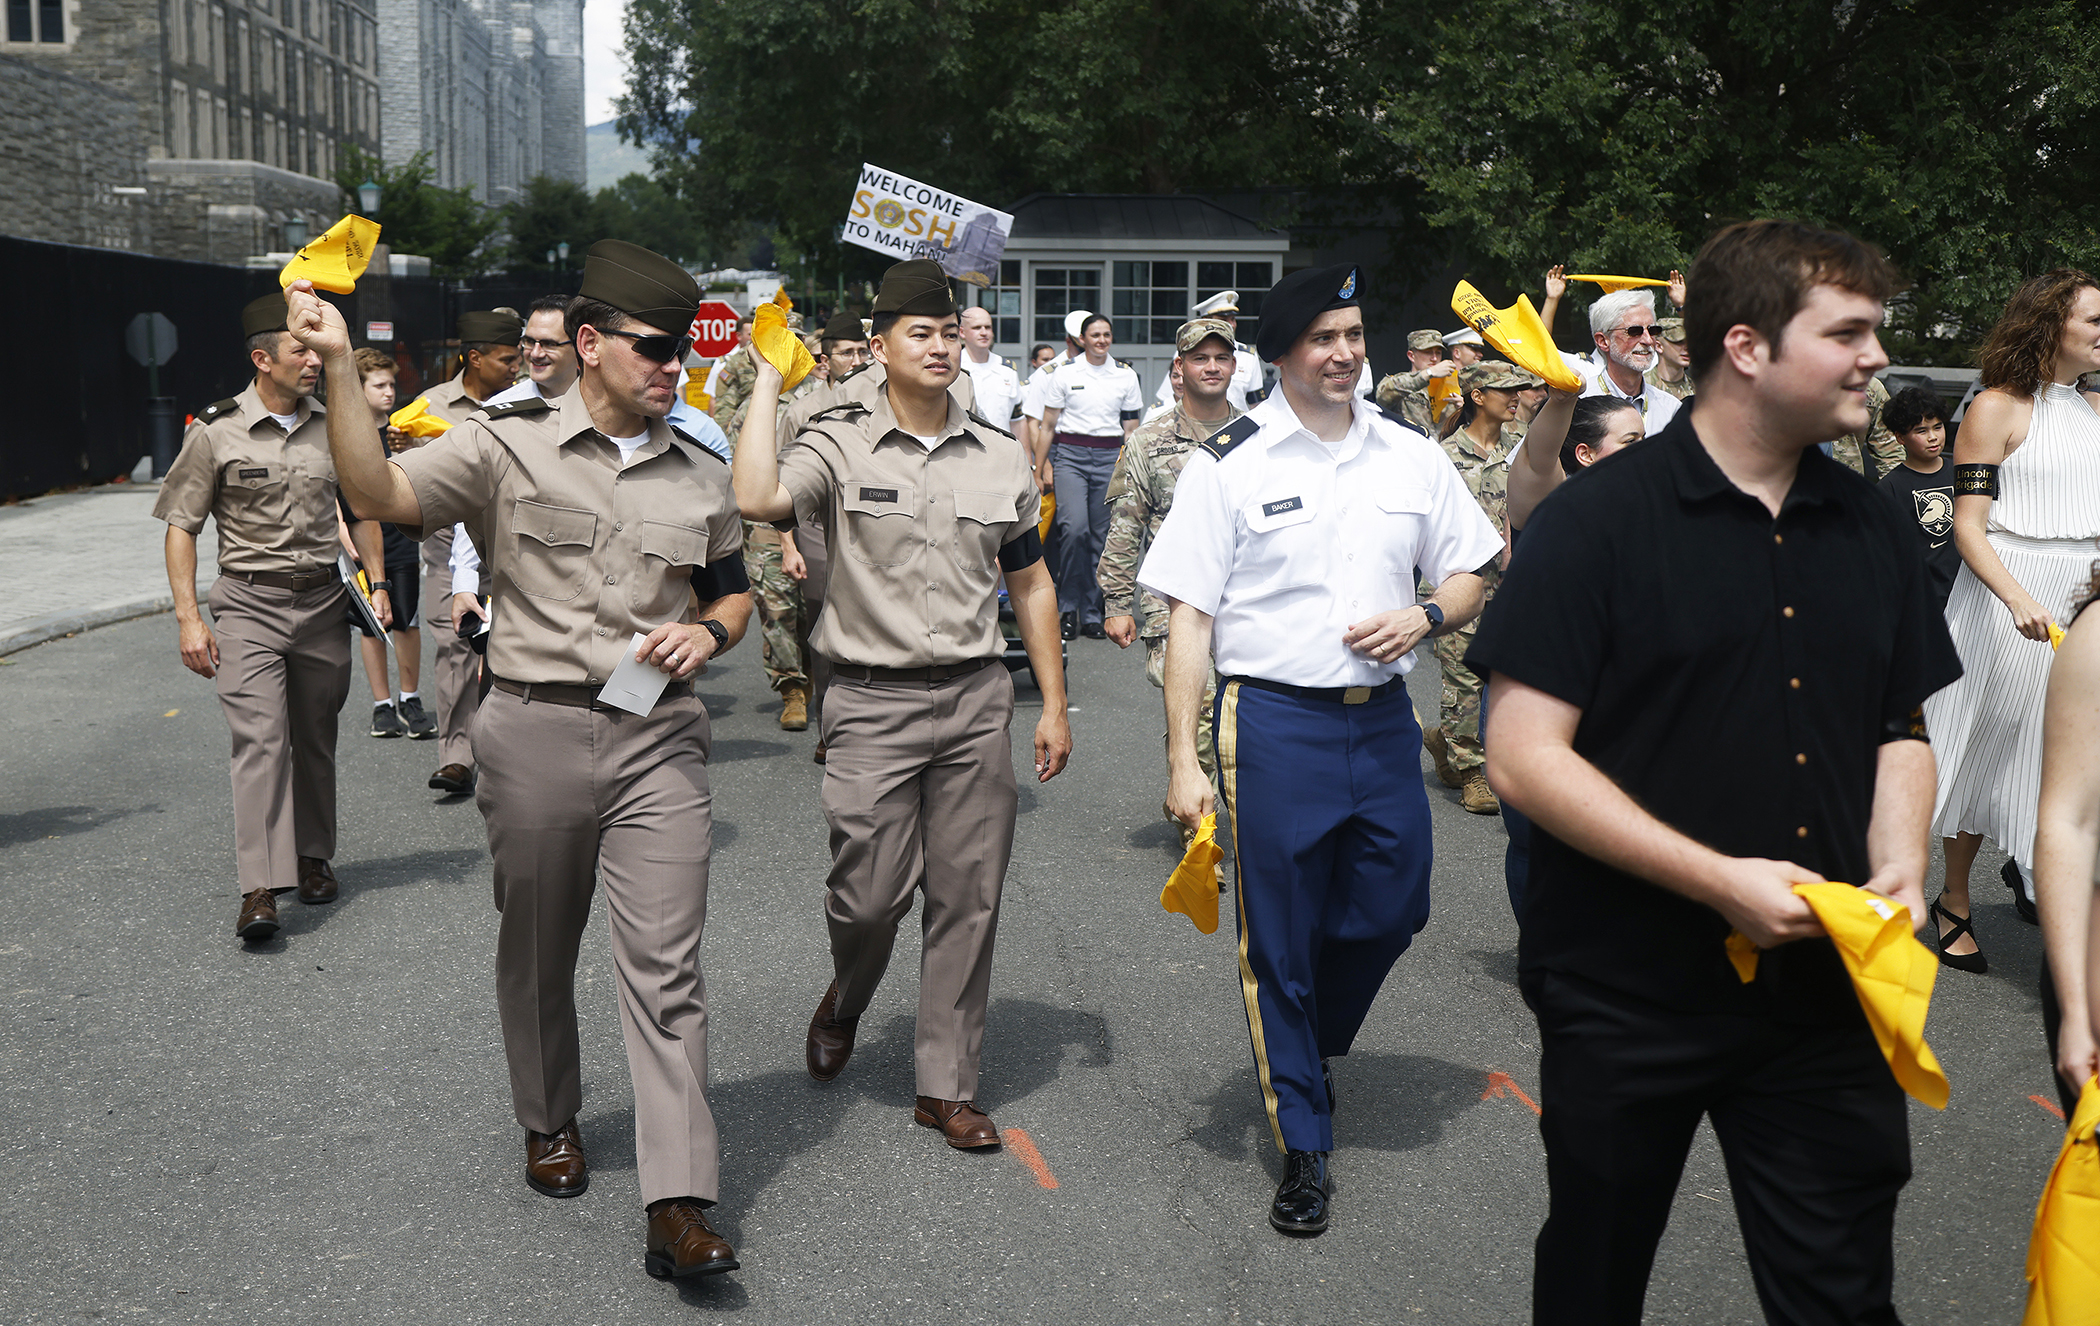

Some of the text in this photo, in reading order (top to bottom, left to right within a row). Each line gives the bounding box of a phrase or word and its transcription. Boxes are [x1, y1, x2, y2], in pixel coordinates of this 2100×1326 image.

[861, 168, 964, 217] WELCOME
[848, 220, 948, 265] TO MAHAN!
[690, 319, 737, 341] STOP
[1957, 469, 1993, 479] Lincoln
[1955, 479, 1993, 491] Brigade
[868, 490, 889, 499] ERWIN
[1271, 501, 1294, 512] BAKER
